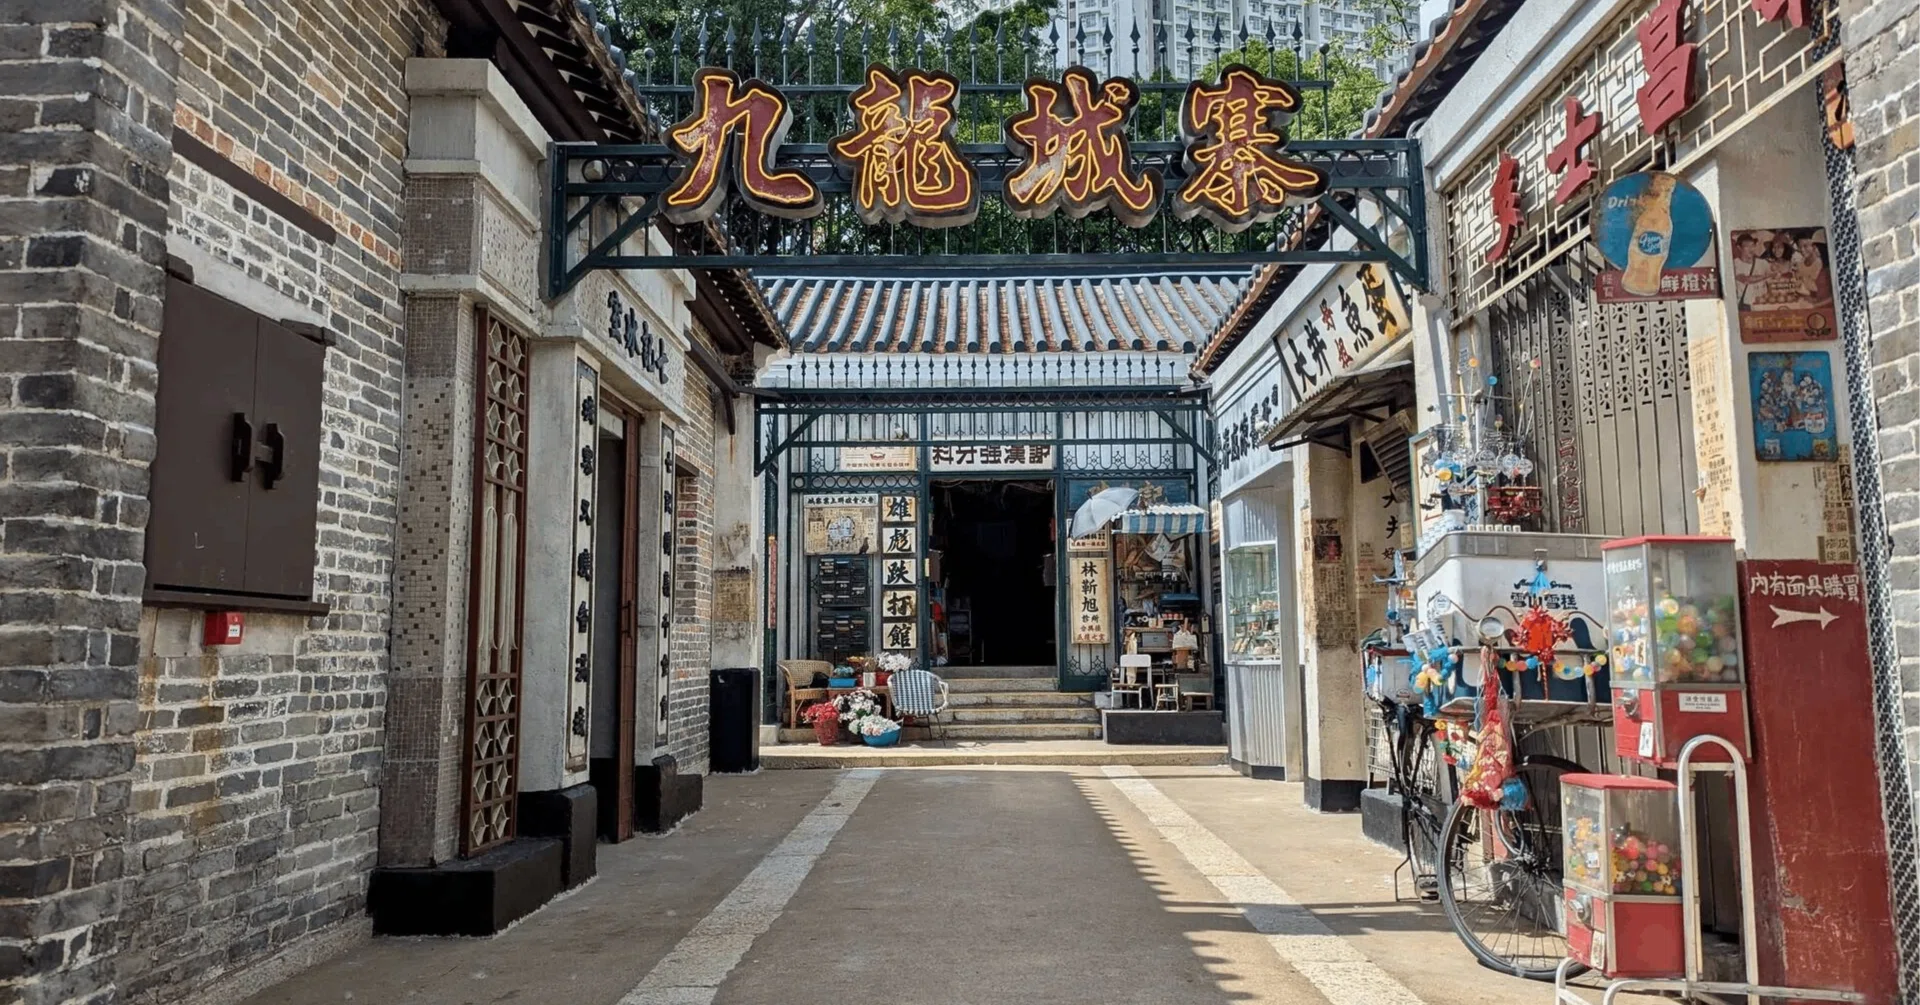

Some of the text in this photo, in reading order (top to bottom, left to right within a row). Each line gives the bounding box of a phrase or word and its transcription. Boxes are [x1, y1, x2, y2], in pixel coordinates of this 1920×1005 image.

[664, 66, 1325, 222] 九龍城寨
[1661, 273, 1717, 292] 鮮橙汁
[886, 497, 913, 647] 雄彪跌打館
[1511, 592, 1578, 610] 雪山雪糕
